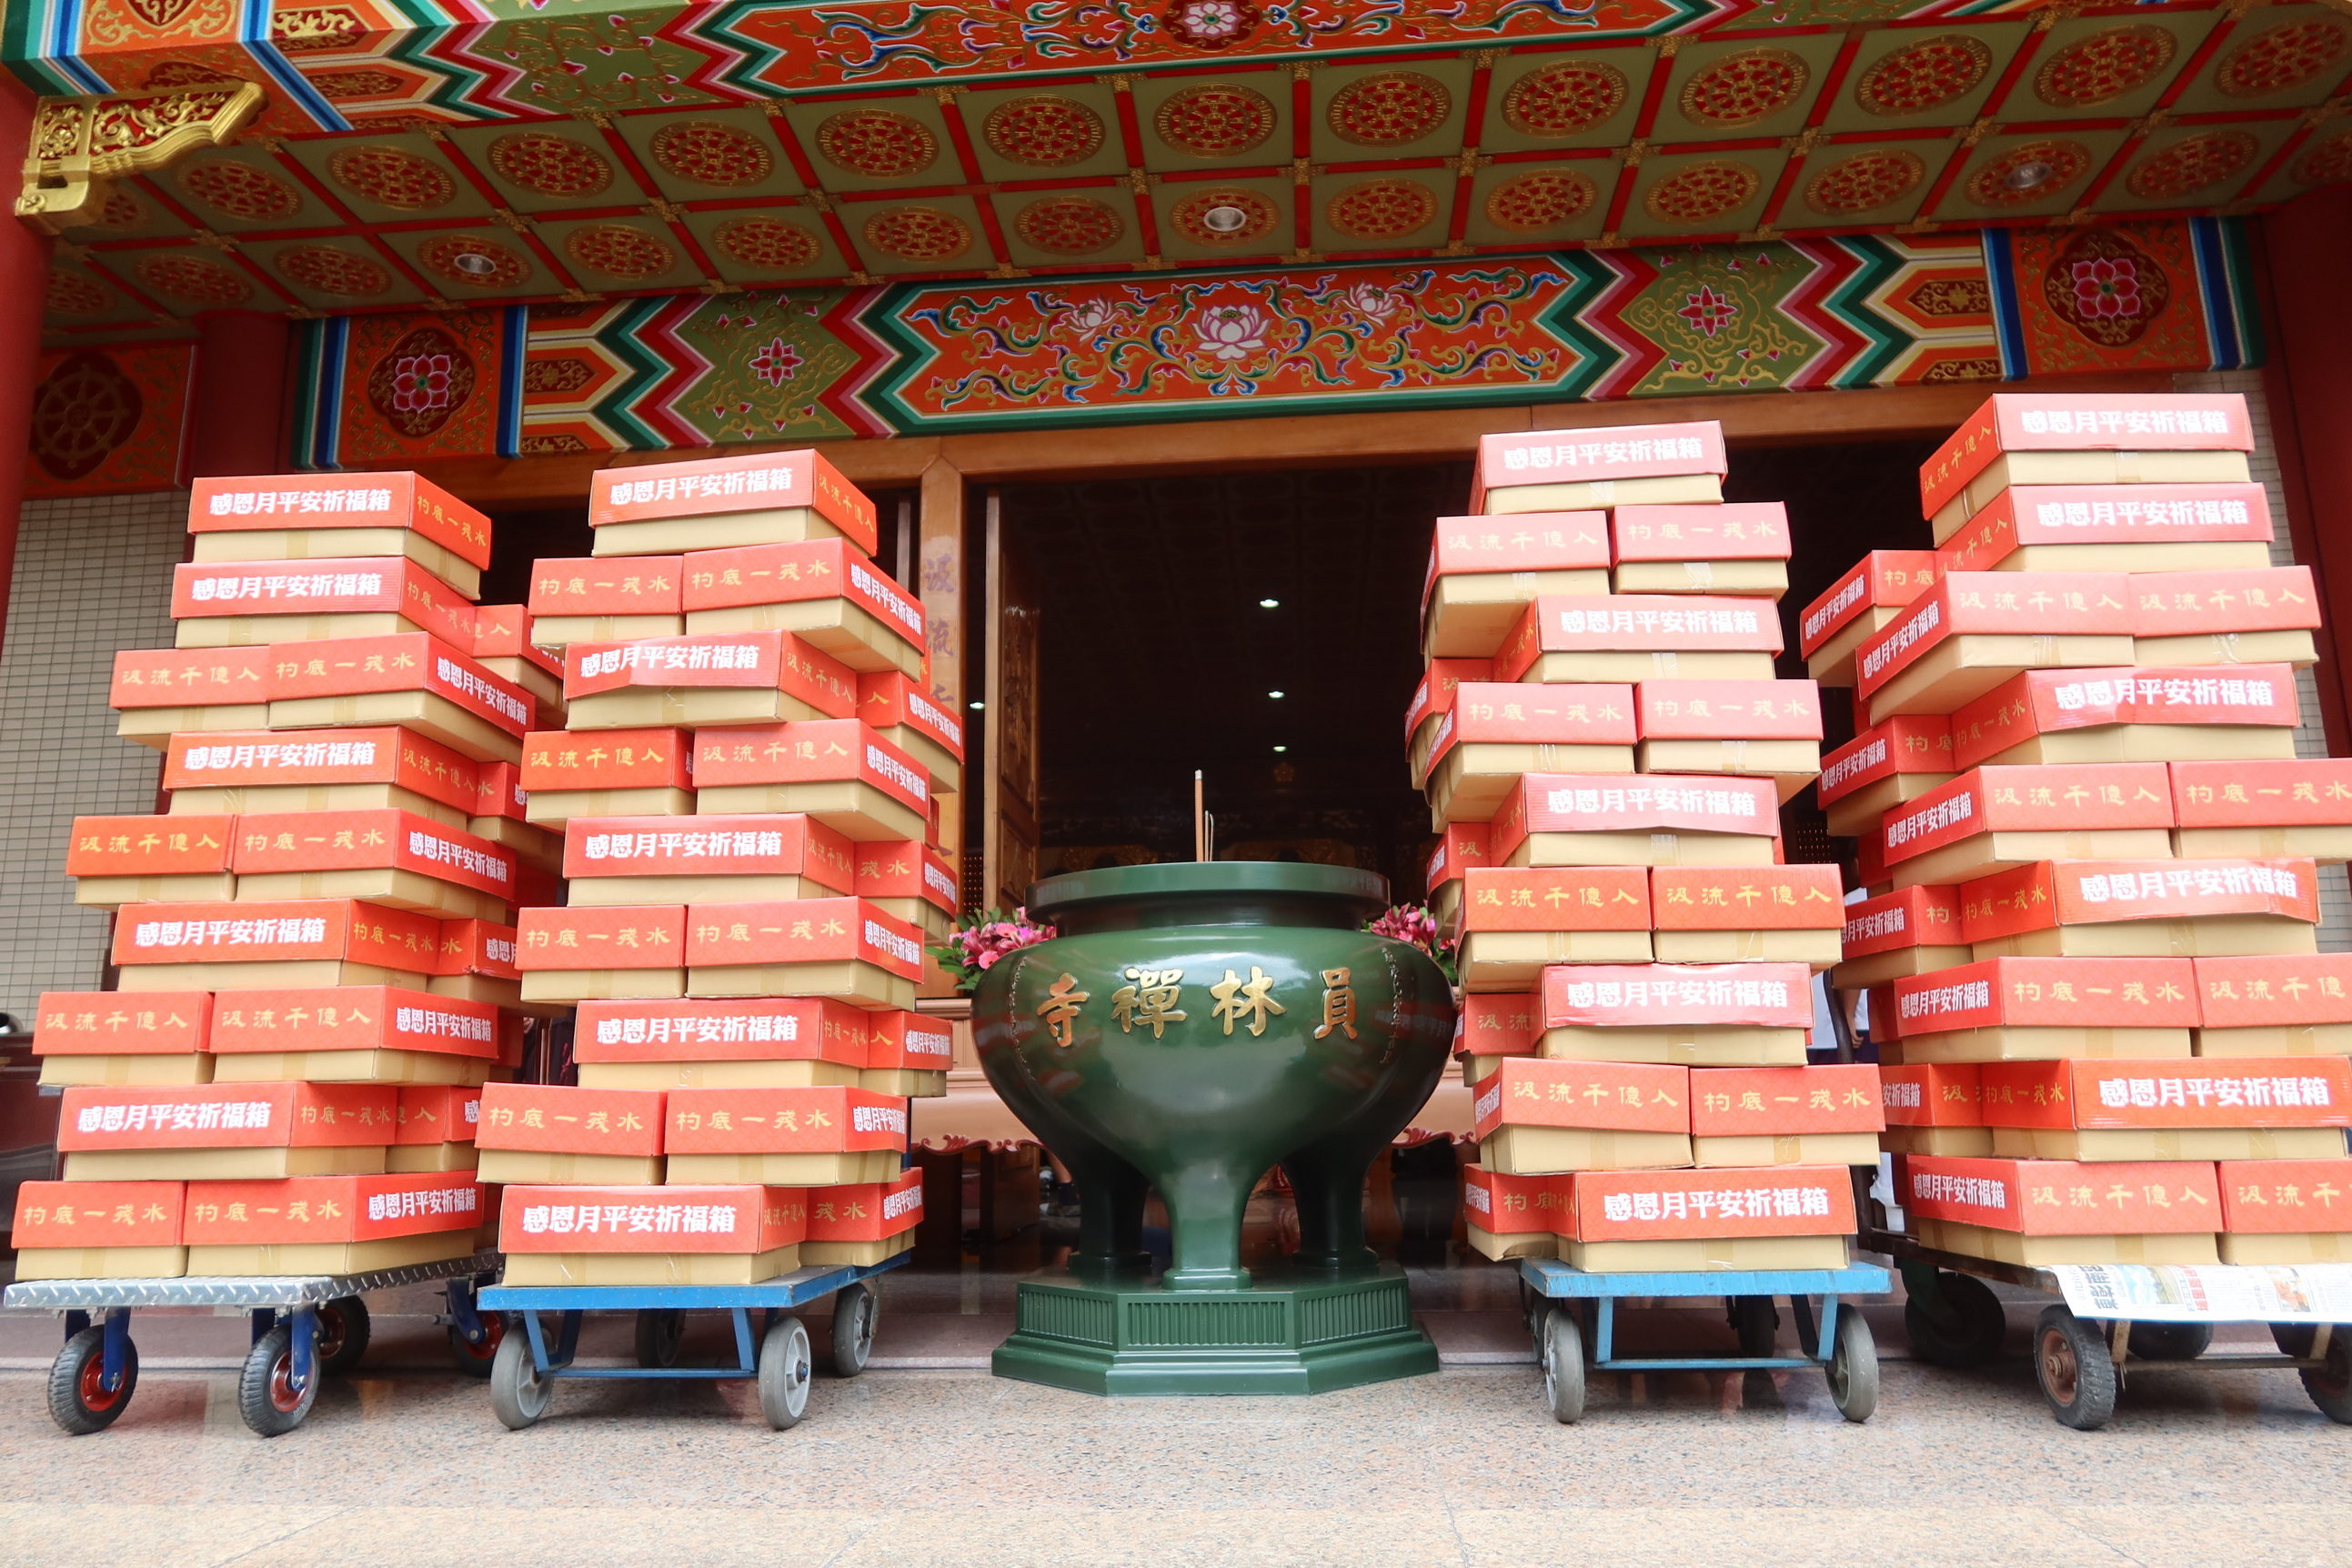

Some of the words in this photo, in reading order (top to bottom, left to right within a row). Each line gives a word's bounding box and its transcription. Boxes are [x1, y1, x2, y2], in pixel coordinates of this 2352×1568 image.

[2022, 411, 2227, 435] 感恩月平安祈福箱
[1504, 437, 1702, 468] 感恩月平安祈福箱
[1924, 424, 1992, 495] 汲流千億人
[610, 467, 792, 505] 感恩月平安祈福箱
[209, 489, 391, 515] 感恩月平安祈福箱
[819, 473, 875, 533] 汲流千億人
[2037, 501, 2248, 528] 感恩月平安祈福箱
[1448, 530, 1597, 550] 汲流千億人
[192, 573, 382, 600] 感恩月平安祈福箱
[850, 563, 921, 636] 感恩月平安祈福箱
[2139, 588, 2305, 611] 汲流千億人
[1804, 574, 1865, 640] 感恩月平安祈福箱
[1960, 591, 2124, 611] 汲流千億人
[1562, 609, 1757, 633] 感恩月平安祈福箱
[1863, 600, 1940, 678] 感恩月平安祈福箱
[581, 645, 759, 677] 感恩月平安祈福箱
[122, 665, 260, 687] 汲流千億人
[787, 651, 853, 703] 汲流千億人
[437, 657, 528, 726] 感恩月平安祈福箱
[2055, 679, 2273, 709] 感恩月平安祈福箱
[186, 742, 376, 769] 感恩月平安祈福箱
[530, 748, 664, 768] 汲流千億人
[703, 741, 848, 763] 汲流千億人
[1821, 739, 1886, 791] 感恩月平安祈福箱
[867, 743, 927, 802] 感恩月平安祈福箱
[1548, 789, 1756, 816] 感恩月平安祈福箱
[1995, 785, 2161, 805] 汲流千億人
[1887, 792, 1972, 848] 感恩月平安祈福箱
[79, 832, 219, 854] 汲流千億人
[409, 831, 508, 882] 感恩月平安祈福箱
[586, 831, 782, 859] 感恩月平安祈福箱
[1477, 887, 1639, 908] 汲流千億人
[1668, 885, 1832, 907] 汲流千億人
[2081, 868, 2297, 902] 感恩月平安祈福箱
[136, 919, 326, 947] 感恩月平安祈福箱
[864, 919, 920, 965] 感恩月平安祈福箱
[1568, 980, 1787, 1008] 感恩月平安祈福箱
[1901, 981, 1989, 1019] 感恩月平安祈福箱
[45, 1011, 188, 1030] 汲流千億人
[223, 1008, 372, 1029] 汲流千億人
[397, 1006, 492, 1042] 感恩月平安祈福箱
[597, 1015, 799, 1044] 感恩月平安祈福箱
[1514, 1081, 1678, 1107] 汲流千億人
[2099, 1077, 2329, 1107] 感恩月平安祈福箱
[77, 1101, 271, 1131] 感恩月平安祈福箱
[368, 1186, 476, 1221] 感恩月平安祈福箱
[1604, 1187, 1829, 1221] 感恩月平安祈福箱
[1914, 1174, 2005, 1210] 感恩月平安祈福箱
[2033, 1185, 2208, 1209] 汲流千億人
[2239, 1184, 2352, 1208] 汲流千
[522, 1205, 737, 1233] 感恩月平安祈福箱
